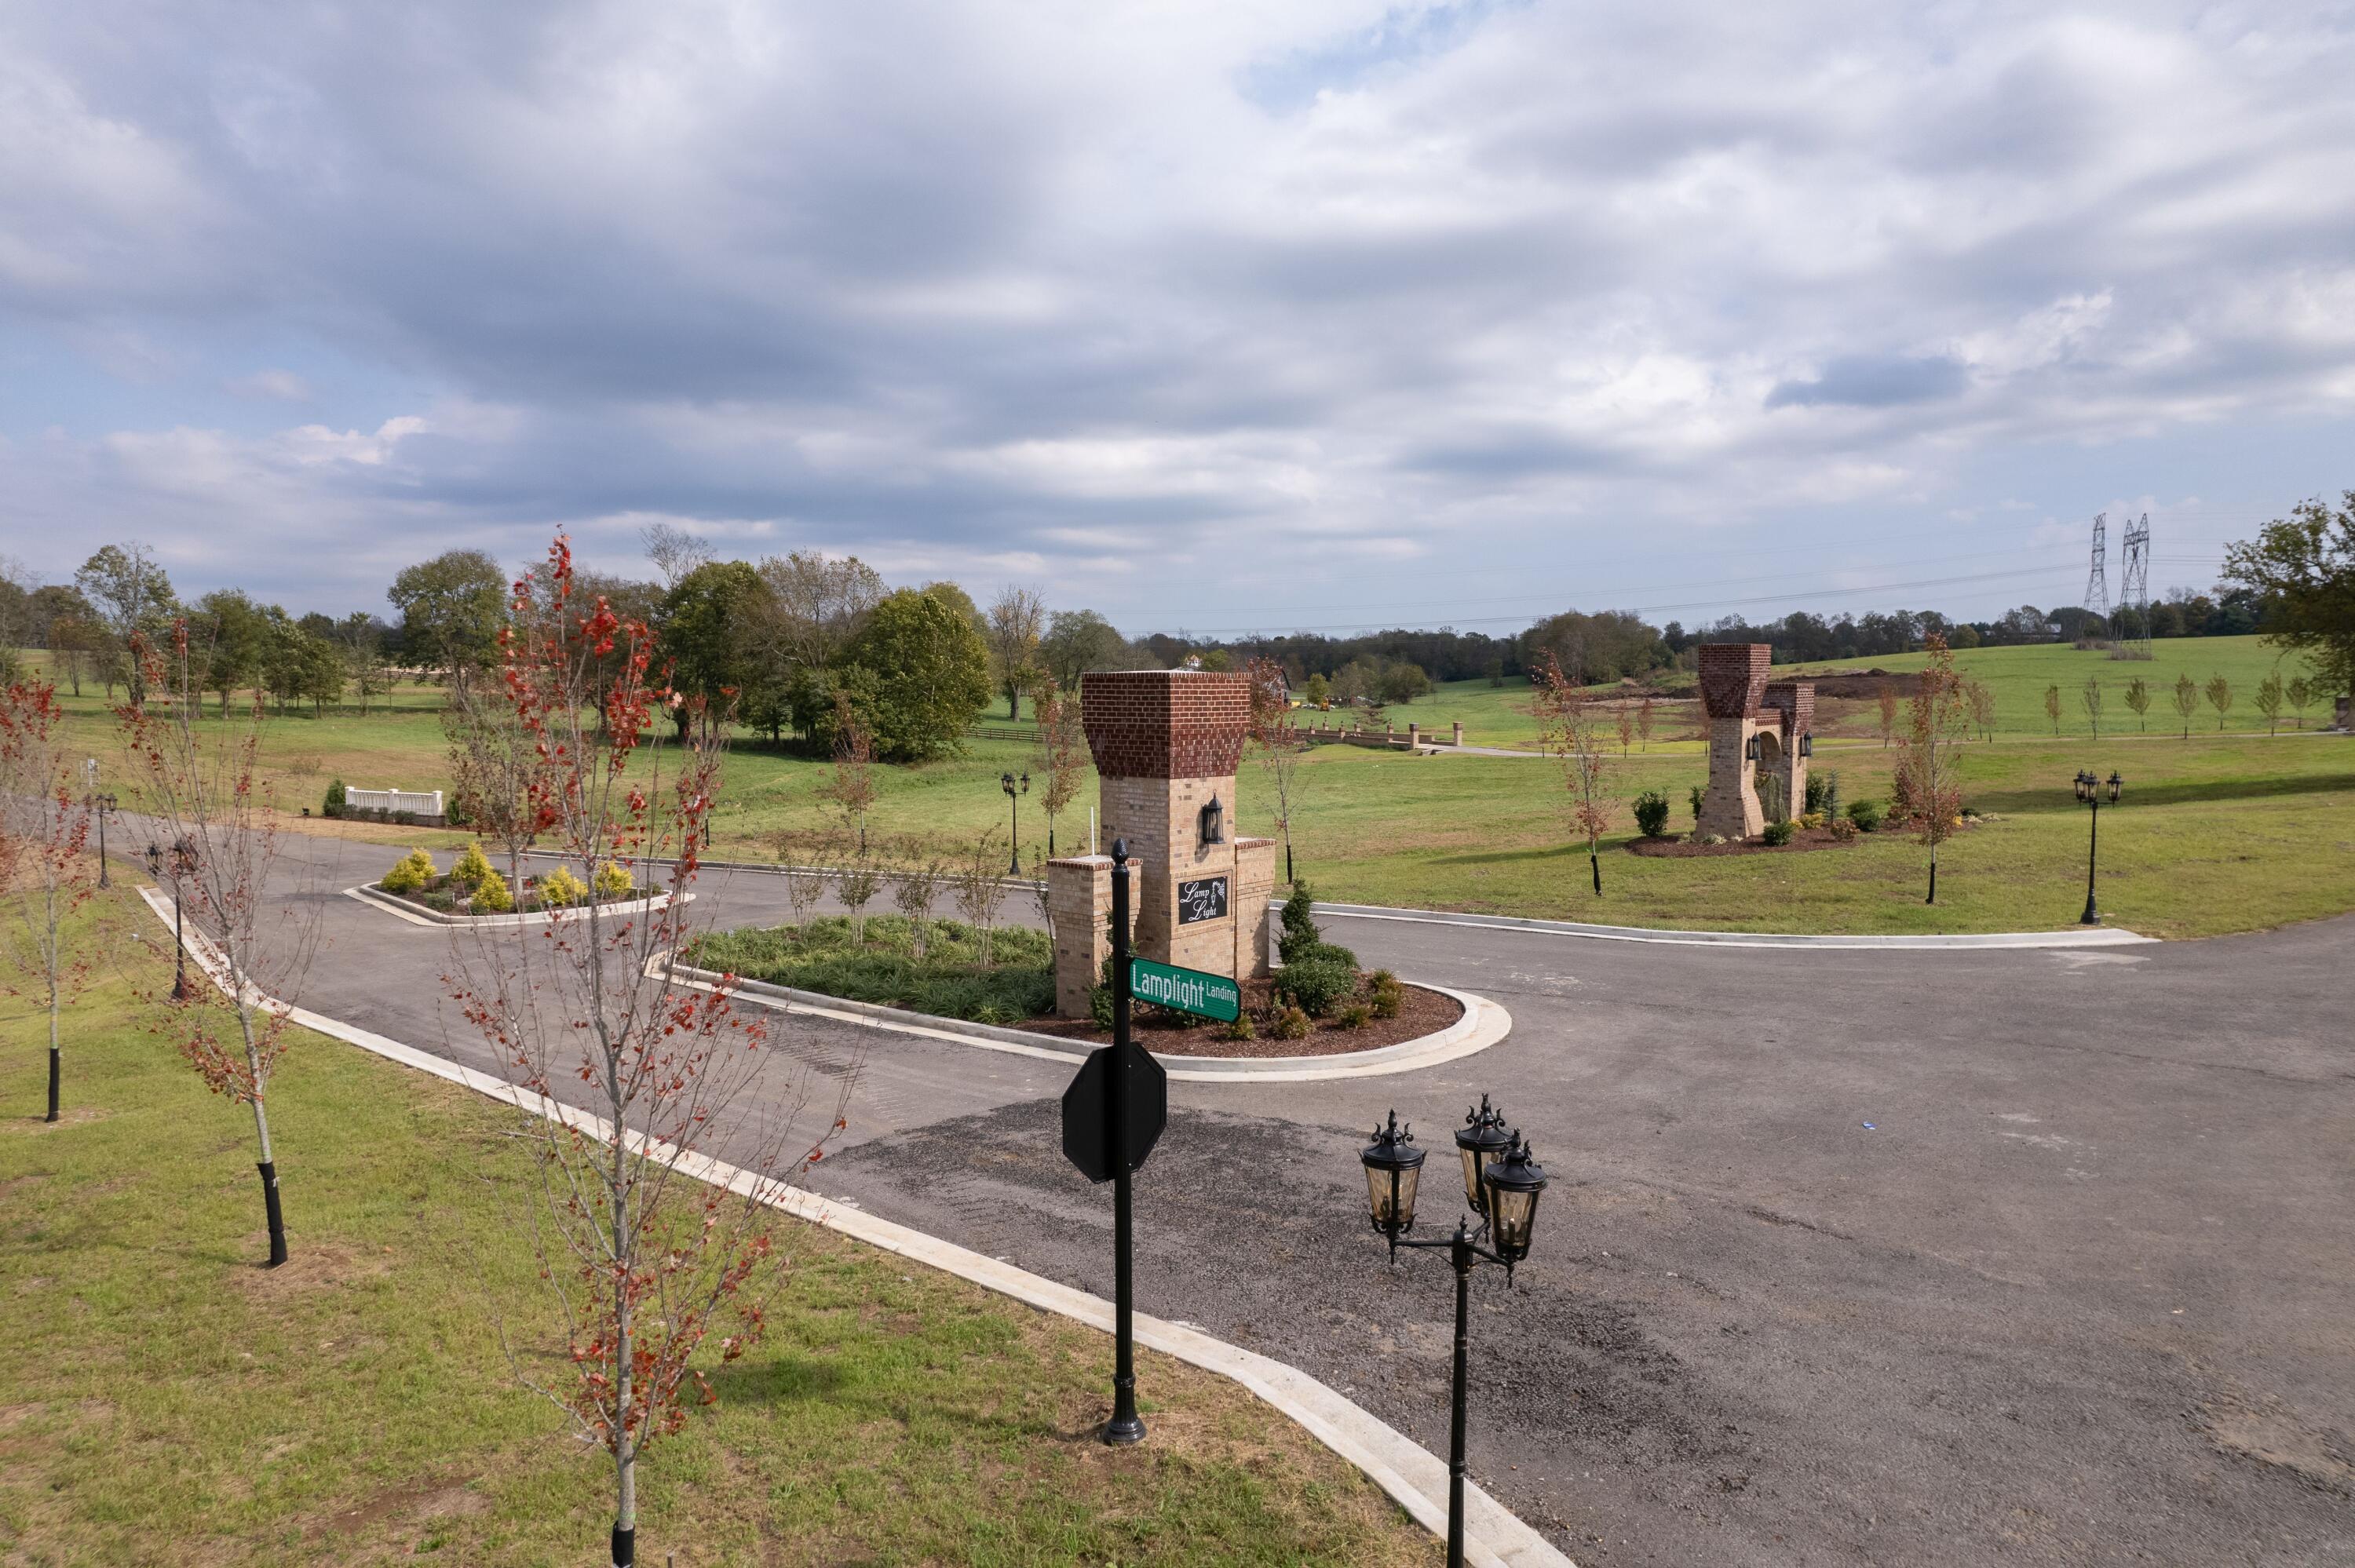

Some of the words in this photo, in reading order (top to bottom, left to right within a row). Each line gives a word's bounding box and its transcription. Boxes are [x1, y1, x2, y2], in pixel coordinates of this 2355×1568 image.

[1180, 882, 1210, 903] Lamp
[1188, 899, 1217, 921] Light
[1133, 964, 1204, 1009] Lamplight
[1206, 981, 1236, 1007] Landing
